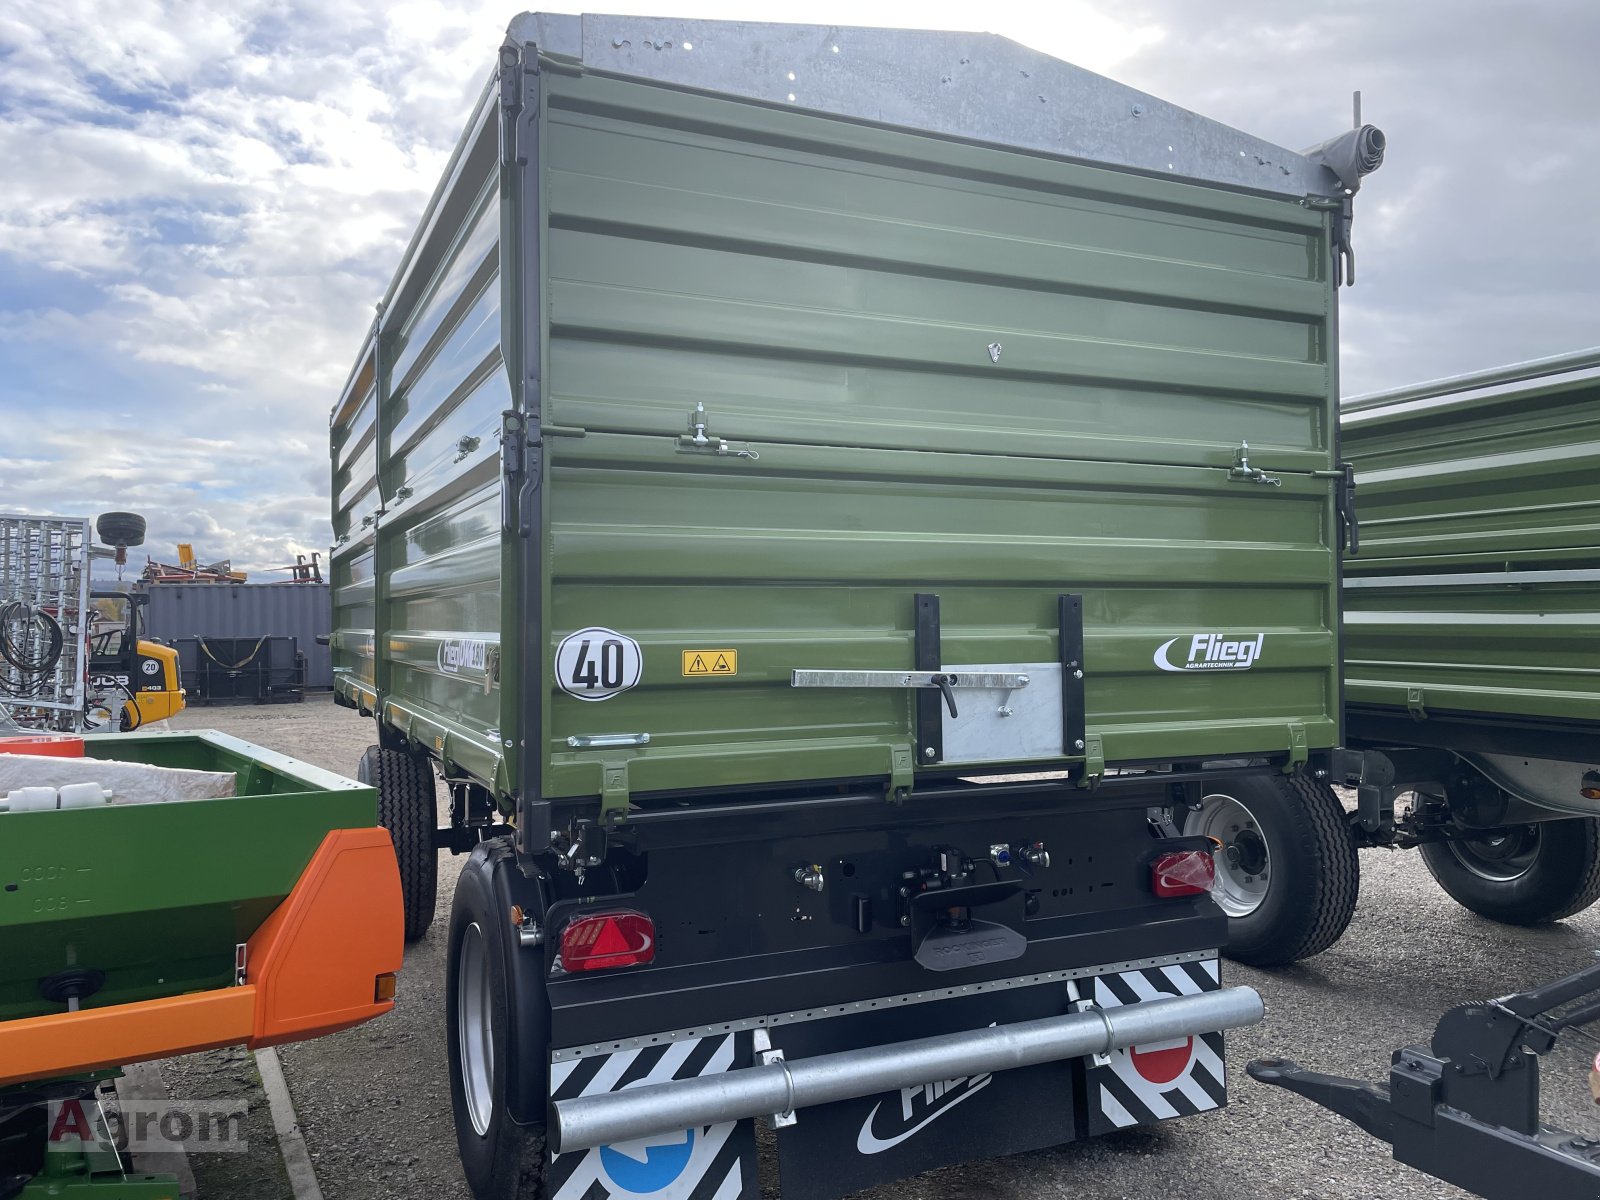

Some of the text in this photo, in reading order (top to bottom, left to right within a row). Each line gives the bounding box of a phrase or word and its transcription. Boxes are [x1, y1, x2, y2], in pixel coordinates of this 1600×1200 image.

[572, 639, 624, 689] 40
[1188, 633, 1264, 667] Fliegl
[91, 676, 129, 686] JCB
